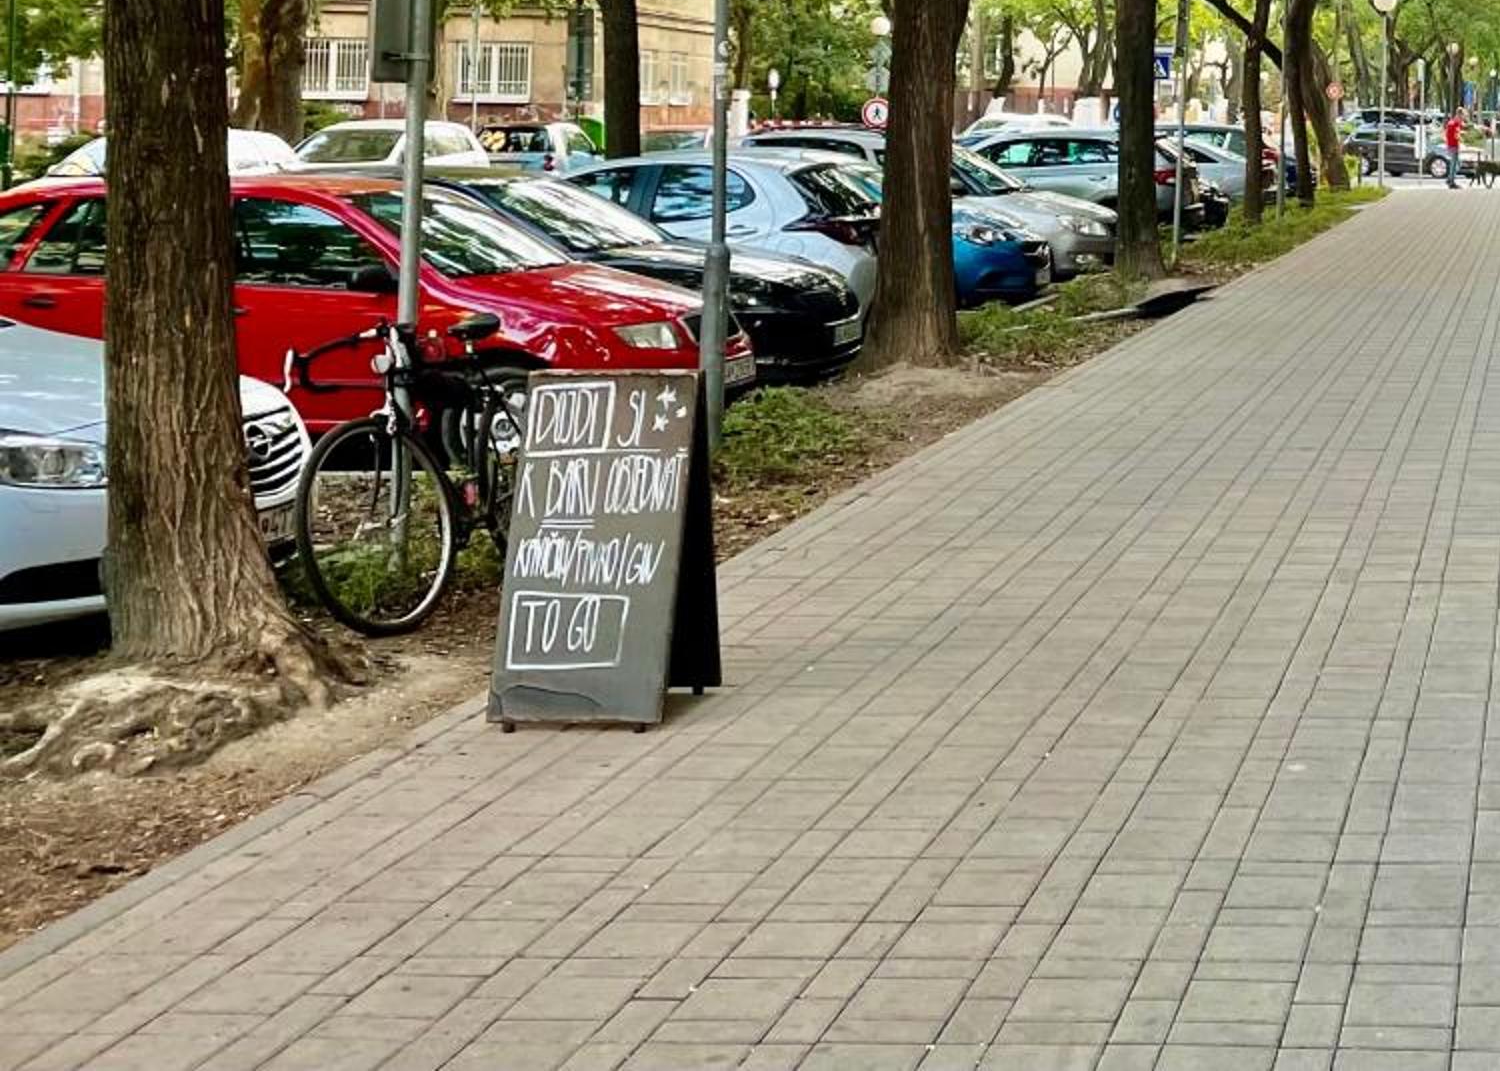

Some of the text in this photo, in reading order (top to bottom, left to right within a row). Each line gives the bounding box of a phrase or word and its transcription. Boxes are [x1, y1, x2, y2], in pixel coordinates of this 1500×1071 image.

[536, 388, 647, 448] DOJDI SI
[517, 461, 536, 519] K
[544, 457, 601, 517] BARU
[521, 595, 601, 654] TO GO
